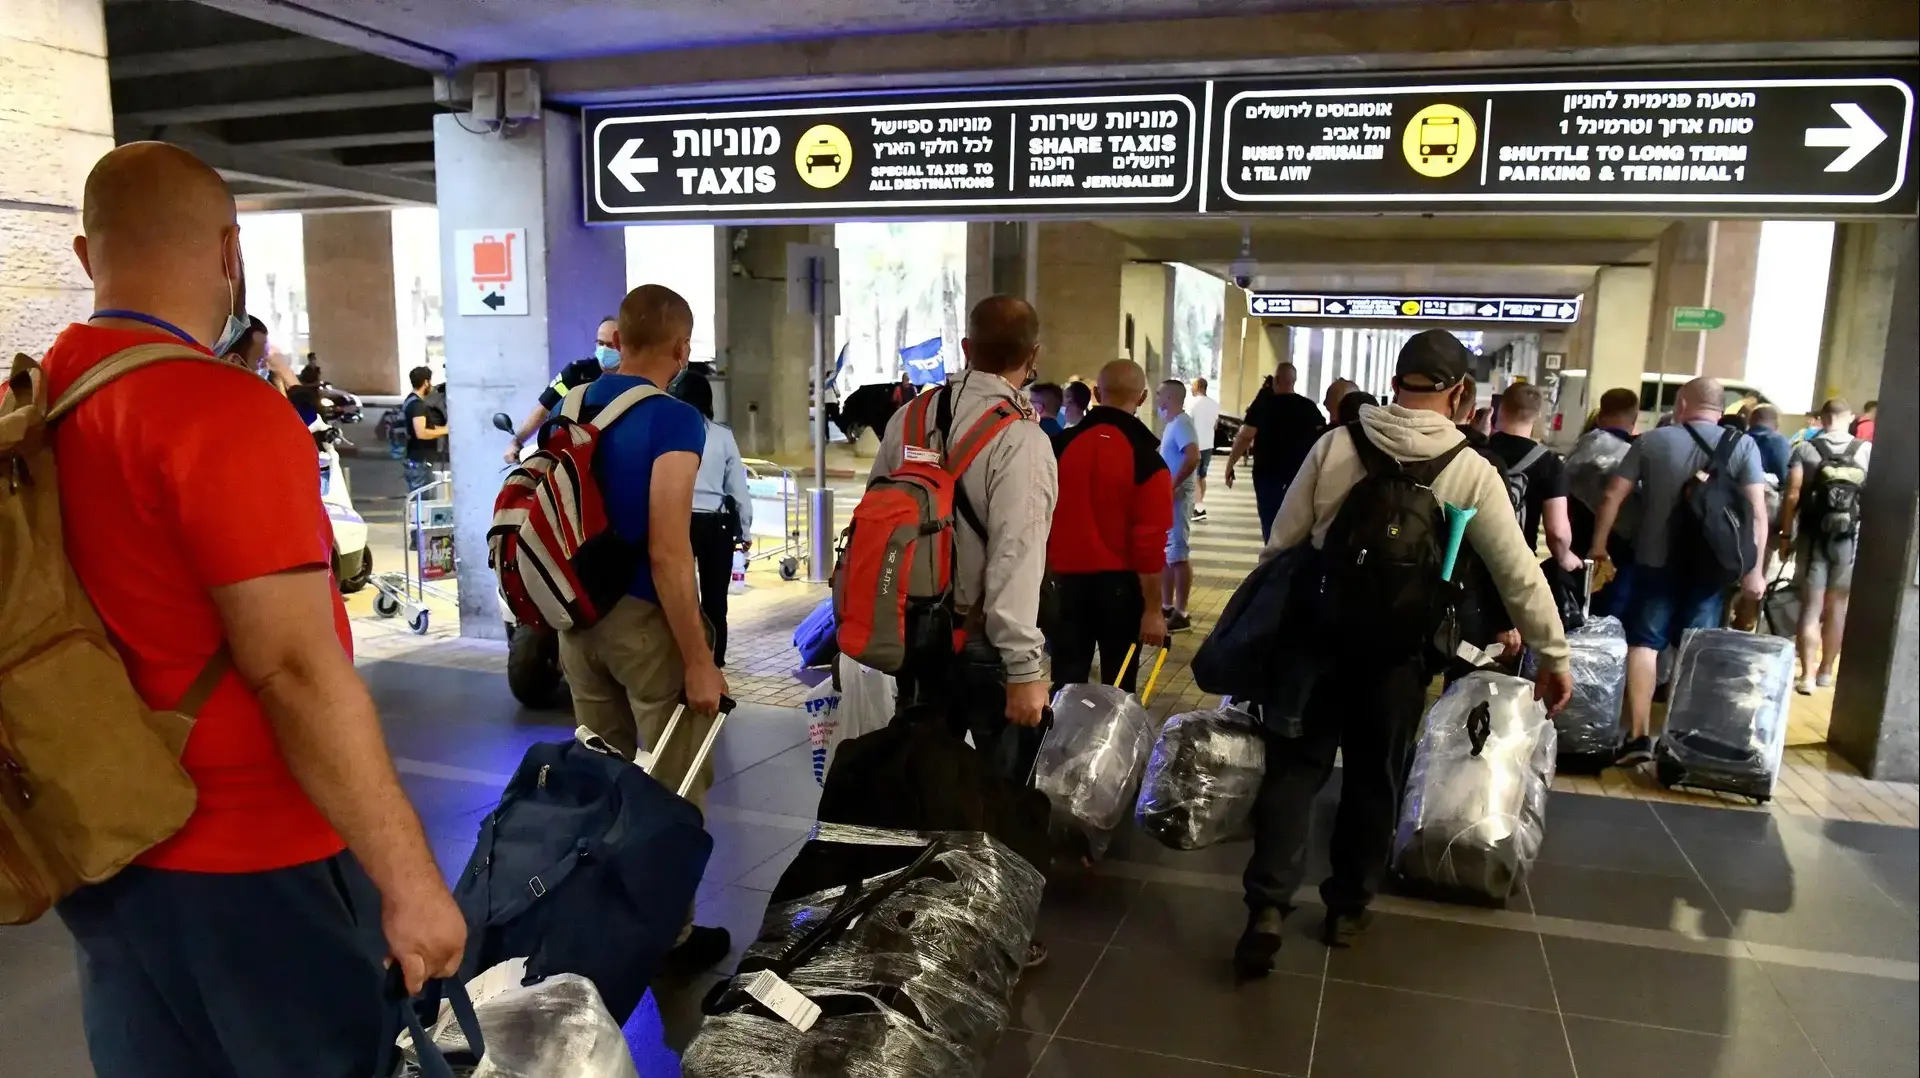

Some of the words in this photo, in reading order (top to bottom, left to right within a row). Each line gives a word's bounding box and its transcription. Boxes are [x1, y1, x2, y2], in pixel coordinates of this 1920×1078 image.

[1564, 91, 1618, 113] לחניון
[1623, 93, 1691, 108] פנימית
[1697, 93, 1755, 109] הסעה
[1246, 101, 1312, 119] לירושלים
[1316, 103, 1392, 117] אוטובוסים
[871, 118, 933, 135] ספיישל
[938, 117, 992, 132] מוניות
[1030, 113, 1097, 131] שירות
[1105, 110, 1178, 129] מוניות
[1559, 120, 1568, 134] 1
[1576, 116, 1652, 134] וטרמינל
[1708, 118, 1753, 134] טווח
[1323, 127, 1359, 140] אביב
[1363, 123, 1391, 140] ותל
[1658, 118, 1703, 138] ארוך
[673, 126, 780, 157] מוניות
[920, 137, 958, 157] חלקי
[963, 136, 993, 153] לכל
[1029, 137, 1102, 154] SHARE
[1108, 134, 1176, 152] TAXIS
[873, 142, 915, 159] הארץ
[1242, 145, 1284, 161] BUSES
[1286, 145, 1304, 160] TO
[1306, 145, 1383, 160] JERUSALEM
[1499, 146, 1589, 161] SHUTTLE
[1596, 145, 1624, 161] TO
[1628, 145, 1685, 161] LONG
[1689, 145, 1747, 161] TERM
[1031, 156, 1074, 170] חיפה
[1113, 153, 1175, 169] ירושלים
[871, 165, 924, 177] SPECIAL
[926, 164, 968, 175] TAXIS
[974, 163, 993, 174] TO
[1241, 166, 1251, 181] &
[1254, 166, 1278, 181] TEL
[1280, 166, 1311, 180] AVIV
[1499, 165, 1590, 181] PARKING
[1599, 166, 1615, 181] &
[1621, 165, 1731, 181] TERMINAL
[1734, 166, 1744, 181] 1
[677, 166, 776, 194] TAXIS
[869, 180, 893, 190] ALL
[894, 177, 994, 190] DESTINATIONS
[1029, 175, 1074, 187] HAIFA
[1082, 174, 1174, 188] JERUSALEM
